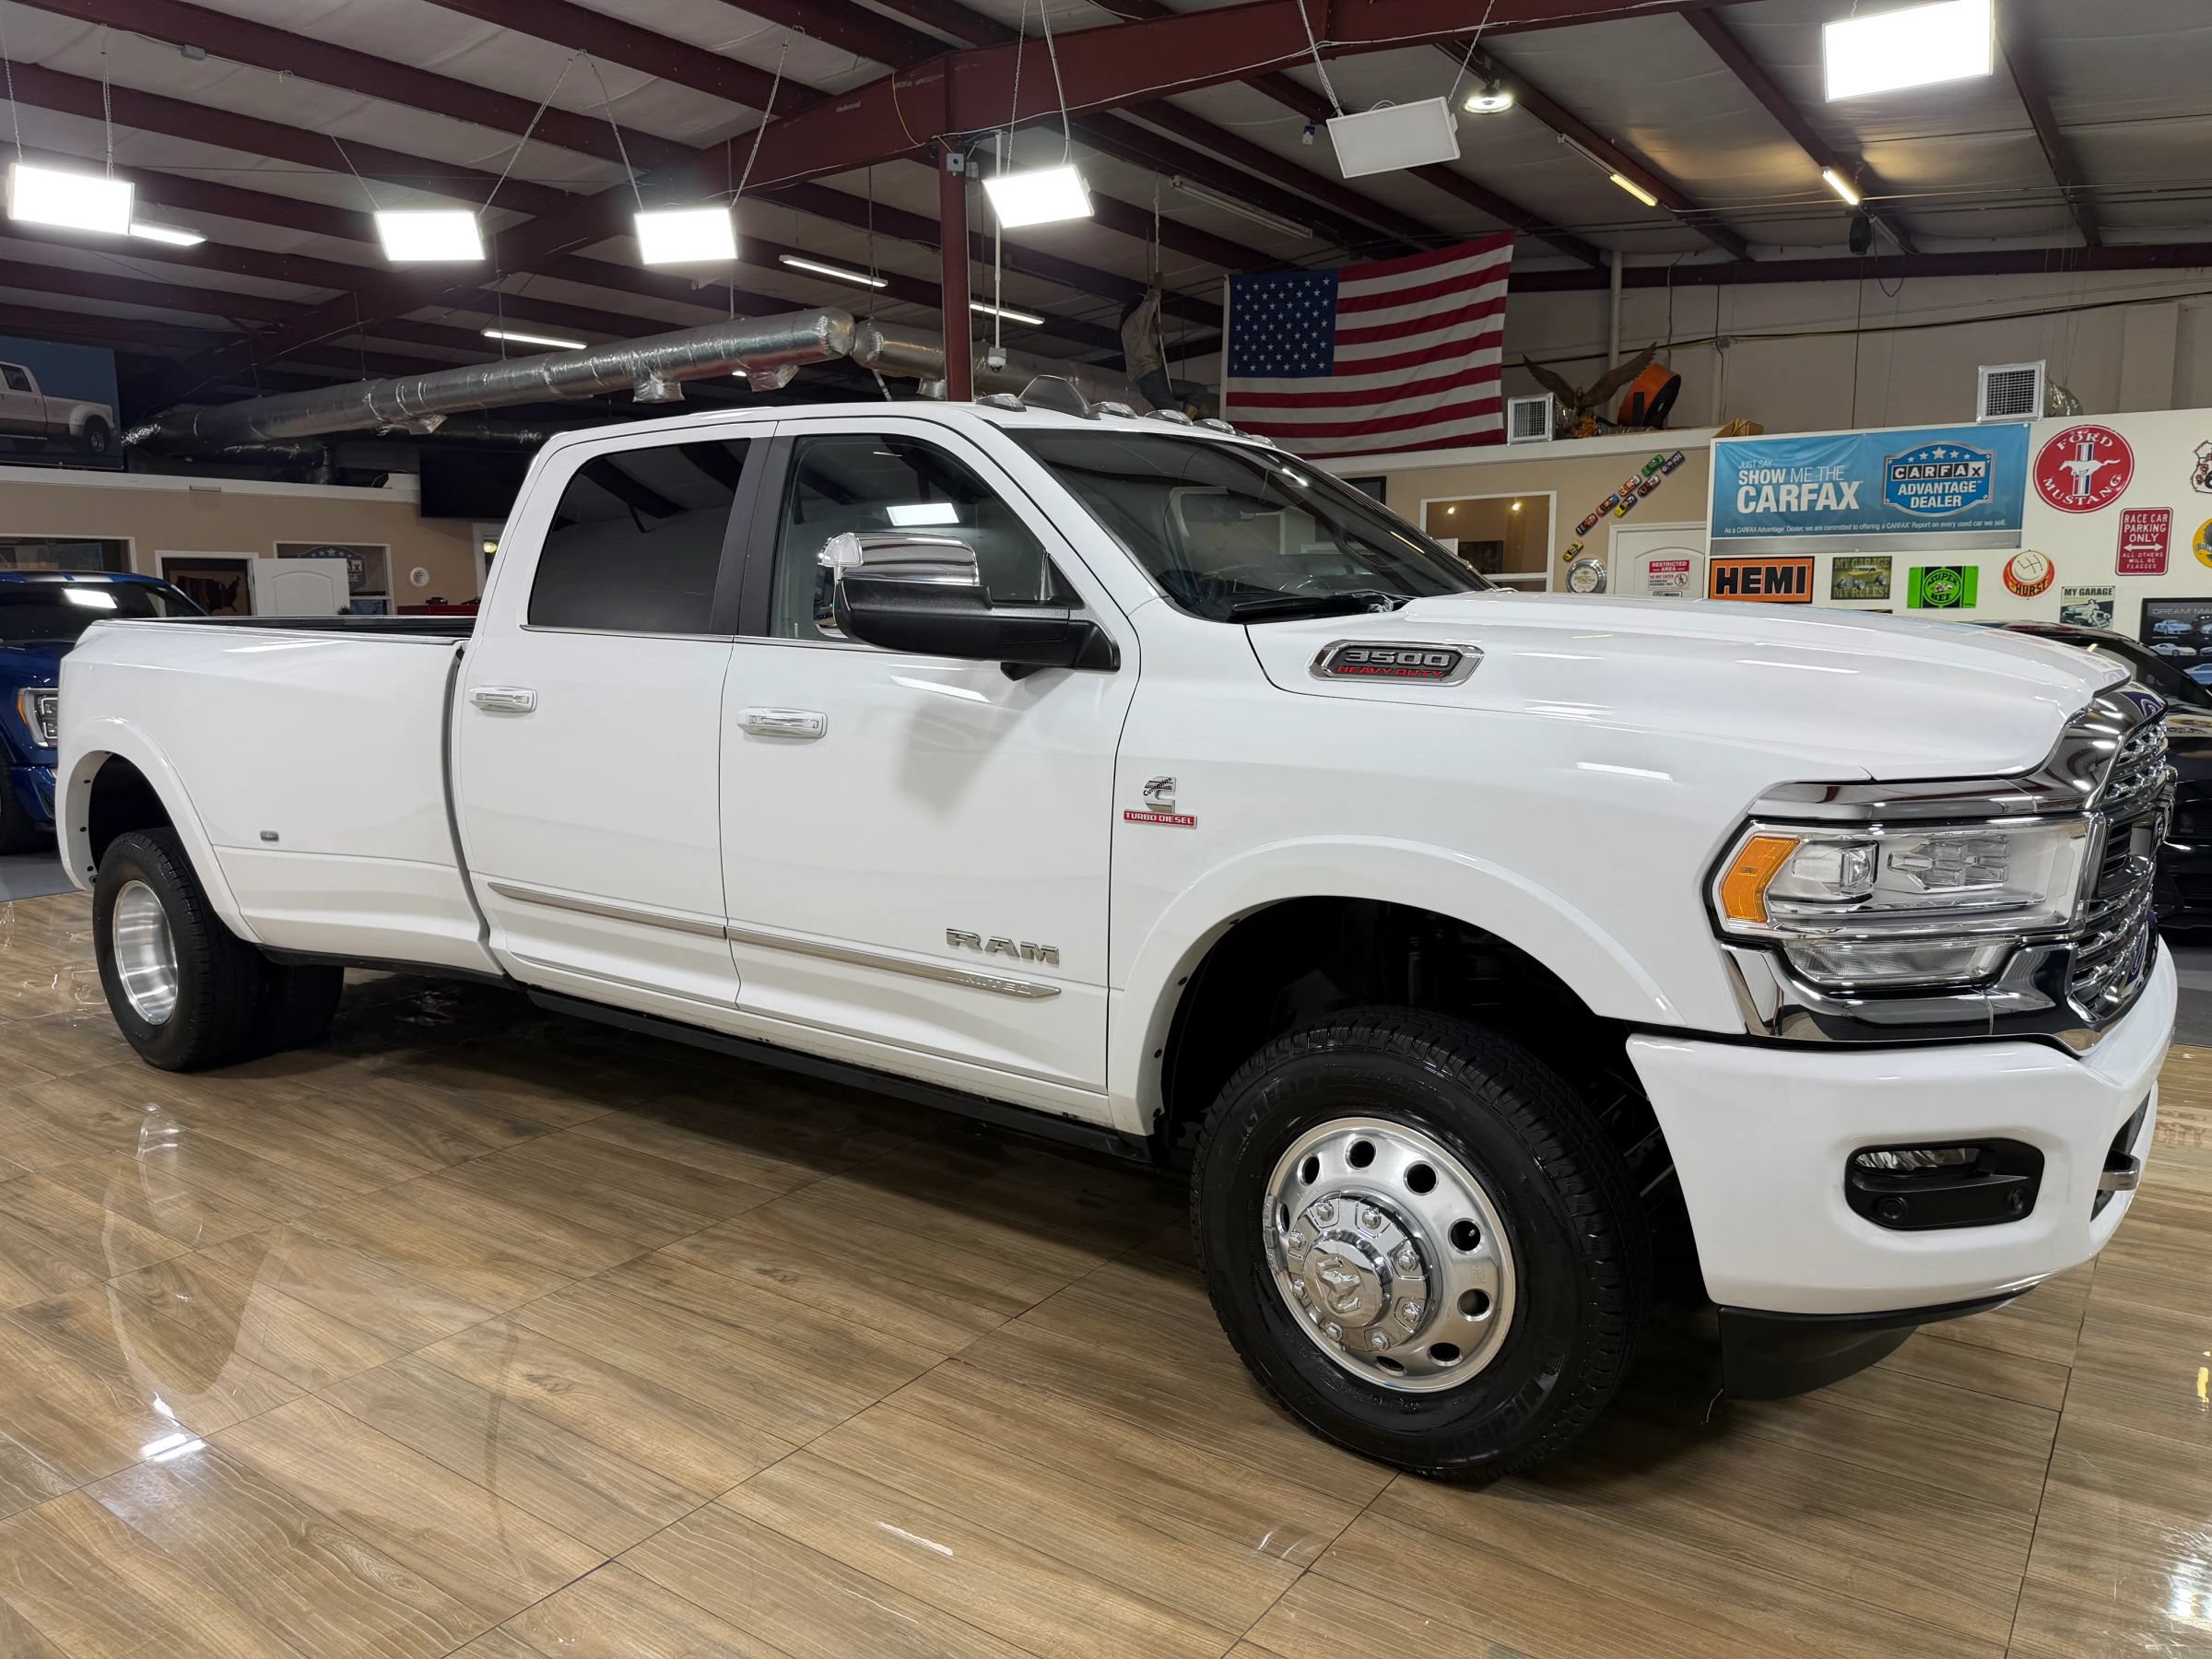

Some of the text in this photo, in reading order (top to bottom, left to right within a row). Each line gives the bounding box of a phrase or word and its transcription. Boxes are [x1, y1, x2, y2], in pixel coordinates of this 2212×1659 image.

[2056, 431, 2113, 450] FORD
[1739, 459, 1772, 469] JUST SAY
[1738, 465, 1845, 485] SHOW ME THE
[1894, 464, 1982, 479] CARFAX
[1898, 480, 1977, 496] ADVANTAGE
[2042, 474, 2123, 506] MUSTANG
[1736, 480, 1861, 513] CARFAX
[1910, 495, 1962, 509] DEALER
[2124, 513, 2168, 524] RACE CAR
[2124, 524, 2167, 533] PARKING
[2129, 533, 2159, 543] ONLY
[1834, 557, 1890, 570] MY GARAGE
[1715, 565, 1807, 595] HEMI
[1928, 572, 1958, 586] SUPER
[1833, 586, 1888, 598] MY RULES!
[2016, 579, 2047, 595] HURST
[2065, 587, 2112, 596] MY GARAGE
[1930, 593, 1952, 602] BEE
[1344, 649, 1452, 666] 3500
[1337, 665, 1444, 677] HEAVY DUTY
[1143, 777, 1172, 796] Cummins
[1124, 812, 1194, 825] TURBO DIESEL
[947, 928, 1059, 965] RAM
